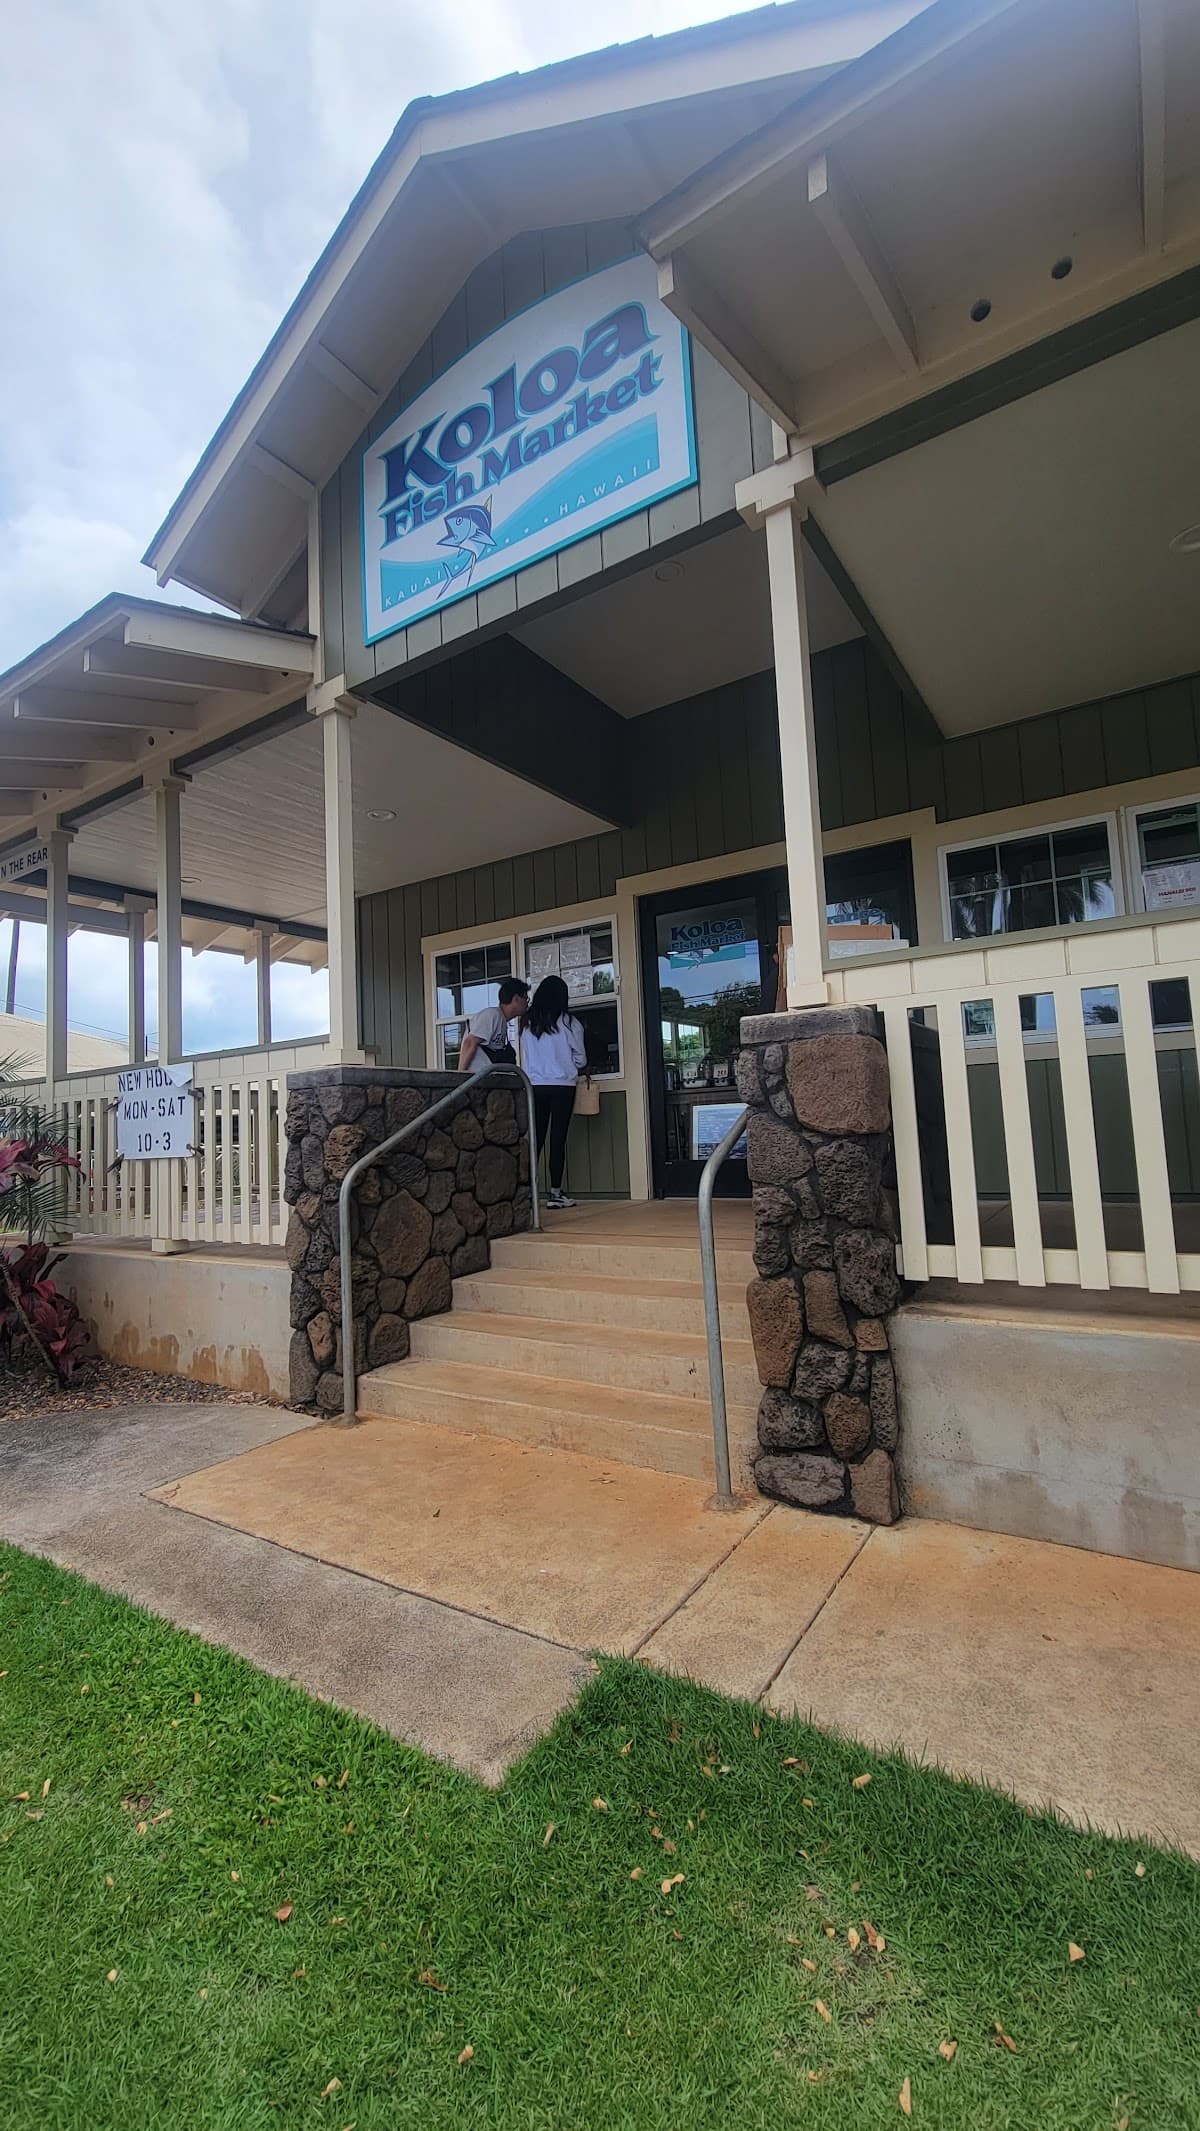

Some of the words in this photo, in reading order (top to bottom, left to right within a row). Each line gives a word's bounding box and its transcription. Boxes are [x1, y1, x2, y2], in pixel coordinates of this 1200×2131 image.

[376, 301, 661, 511] Koloa
[378, 465, 476, 551] Fish
[476, 350, 664, 487] Market
[385, 569, 441, 608] KAUAI
[559, 459, 651, 516] HAWAII
[9, 857, 24, 874] THE
[27, 847, 48, 867] REAR
[671, 917, 745, 941] Koloa
[671, 940, 699, 952] Fish
[699, 931, 745, 949] Market
[118, 1072, 141, 1092] NEW
[146, 1069, 173, 1088] HOU
